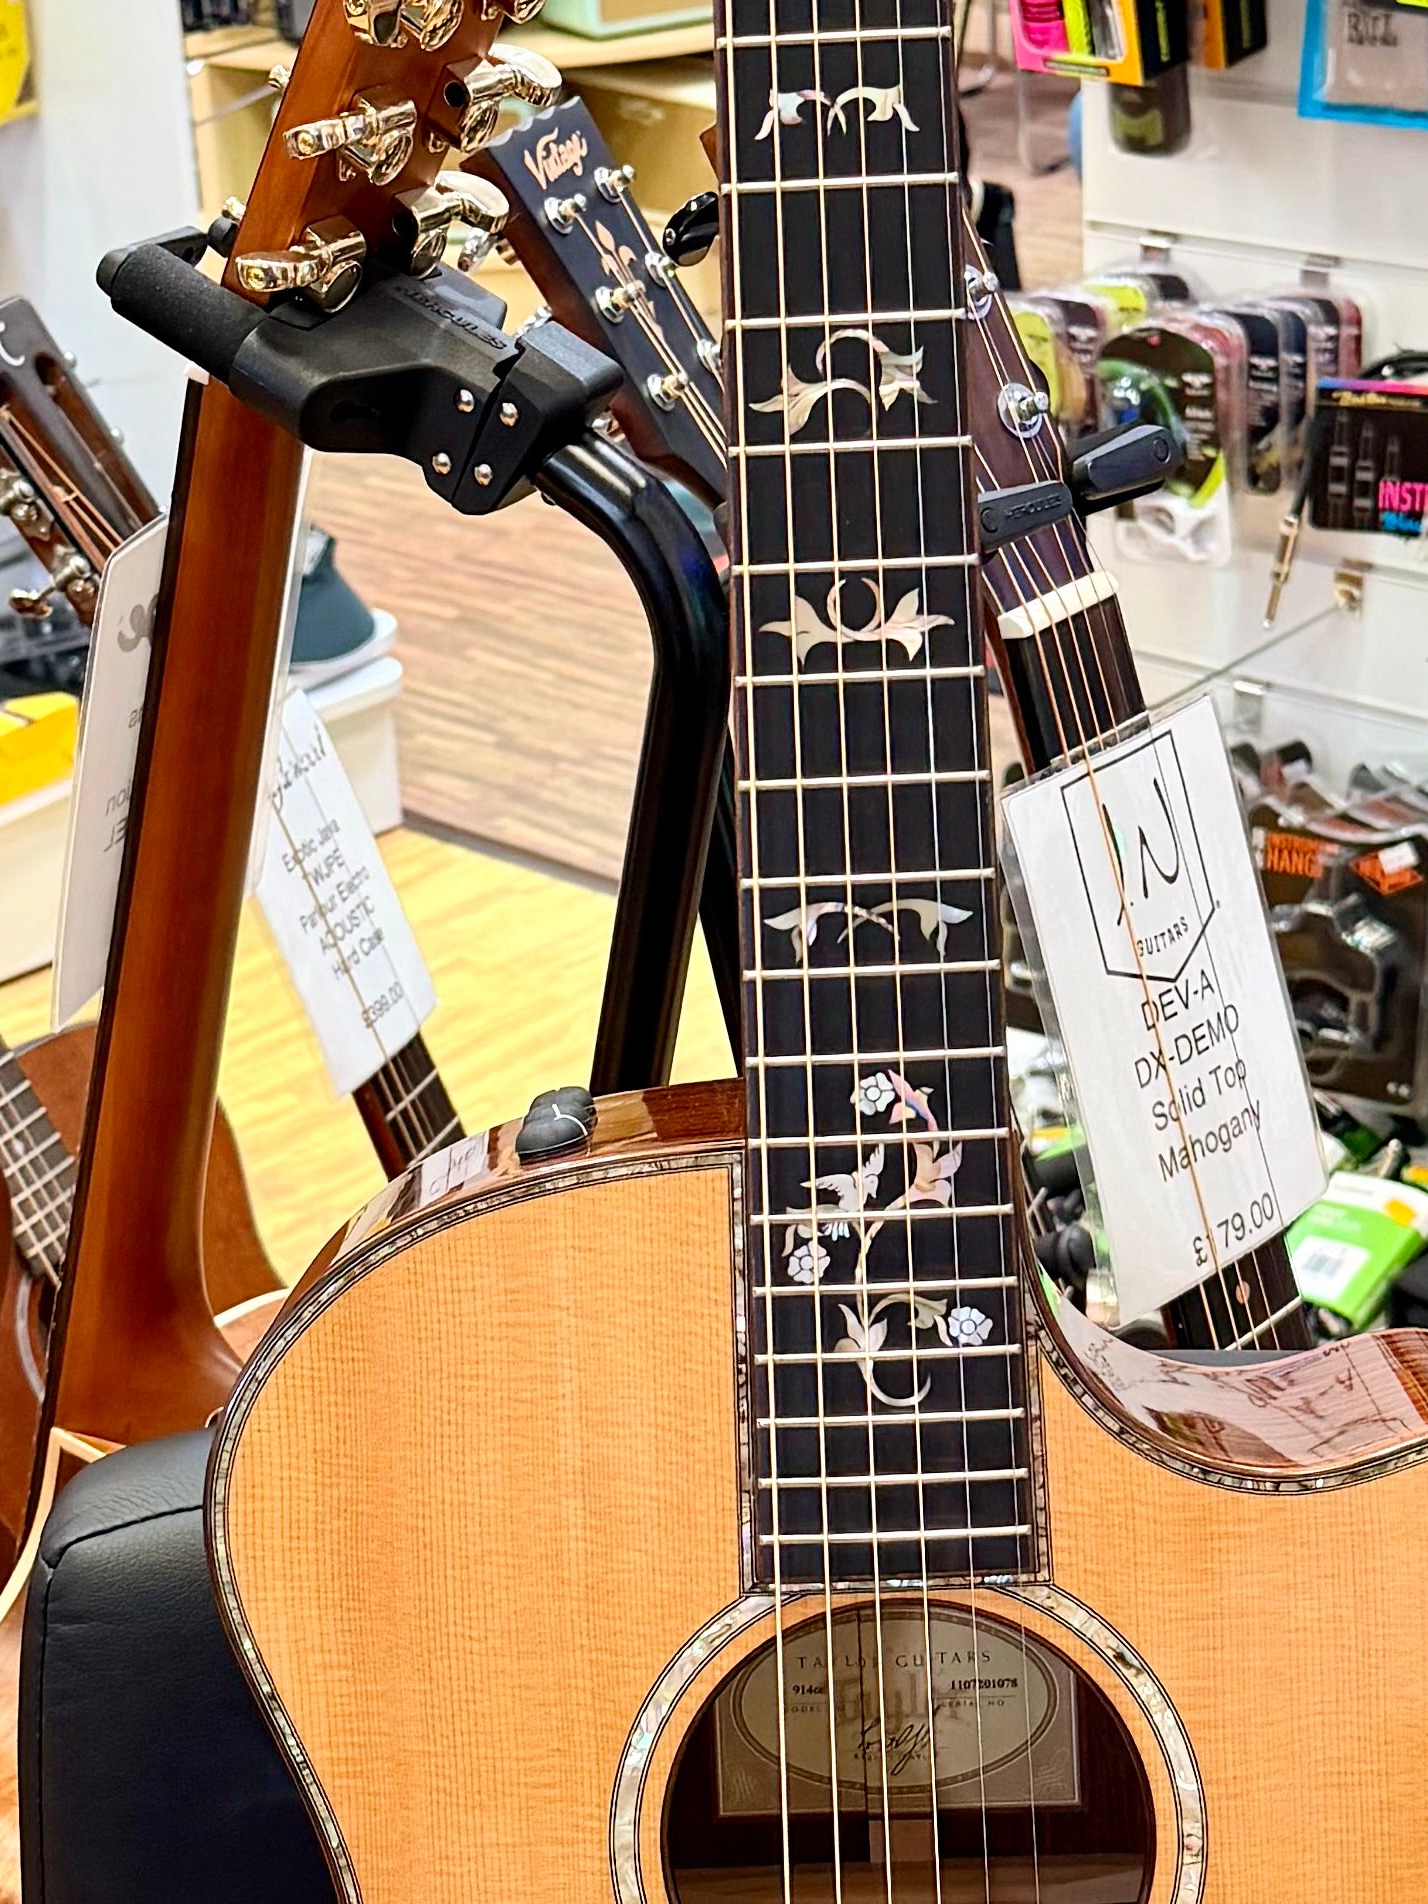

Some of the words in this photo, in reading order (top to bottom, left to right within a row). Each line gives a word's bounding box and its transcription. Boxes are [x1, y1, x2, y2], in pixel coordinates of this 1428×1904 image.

[523, 126, 589, 192] Vintage
[302, 847, 346, 887] WJPE
[1141, 968, 1217, 1033] DEV-A
[1134, 1002, 1241, 1090] DX-DEMO
[1151, 1085, 1207, 1133] Solid
[1209, 1056, 1249, 1099] Top
[1158, 1098, 1262, 1184] Mahogany
[1192, 1190, 1276, 1268] £79.00
